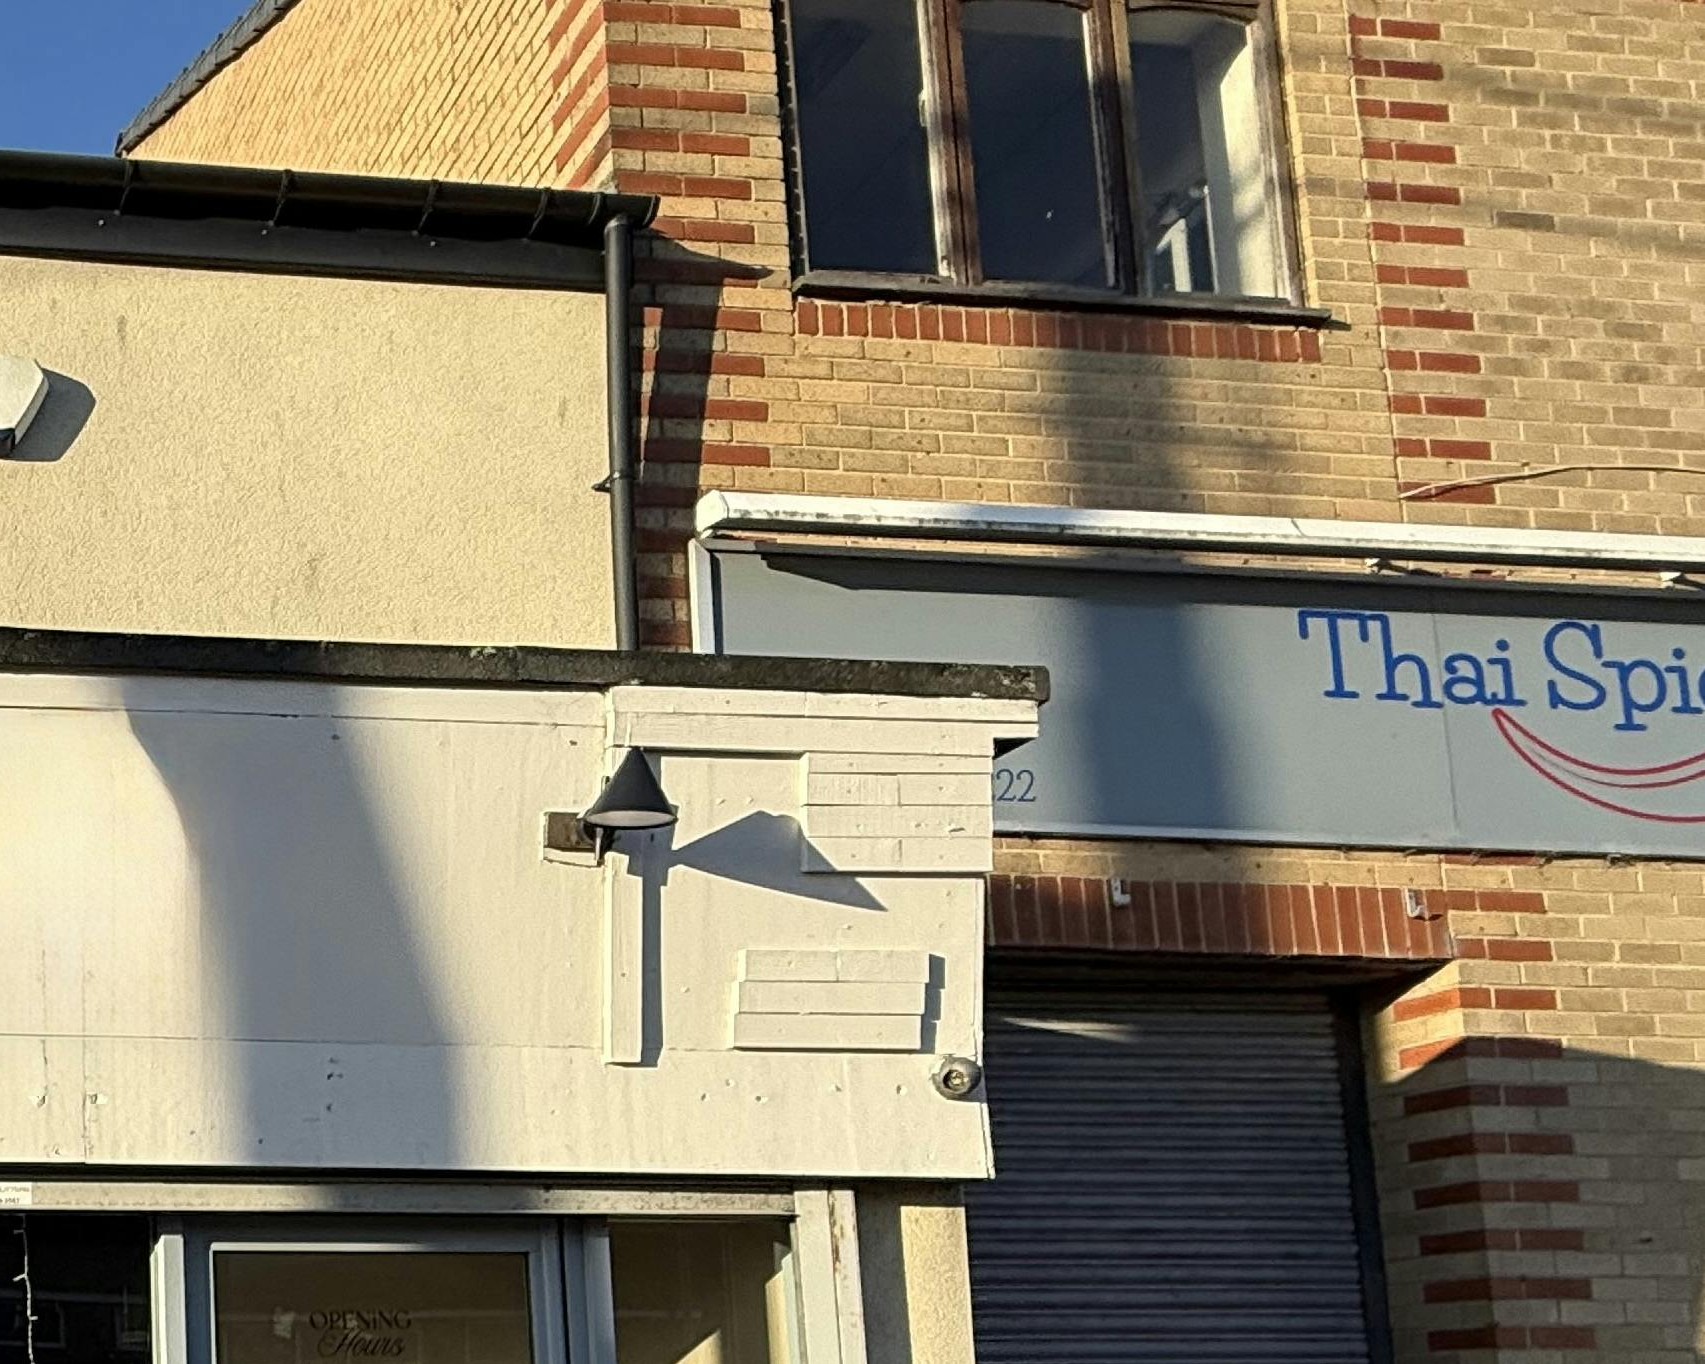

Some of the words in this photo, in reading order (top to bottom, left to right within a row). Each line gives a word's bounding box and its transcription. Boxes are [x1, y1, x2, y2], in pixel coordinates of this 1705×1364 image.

[1297, 609, 1529, 709] Thai
[1543, 620, 1705, 732] Spi
[992, 768, 1036, 802] 22
[316, 1327, 407, 1359] Hours
